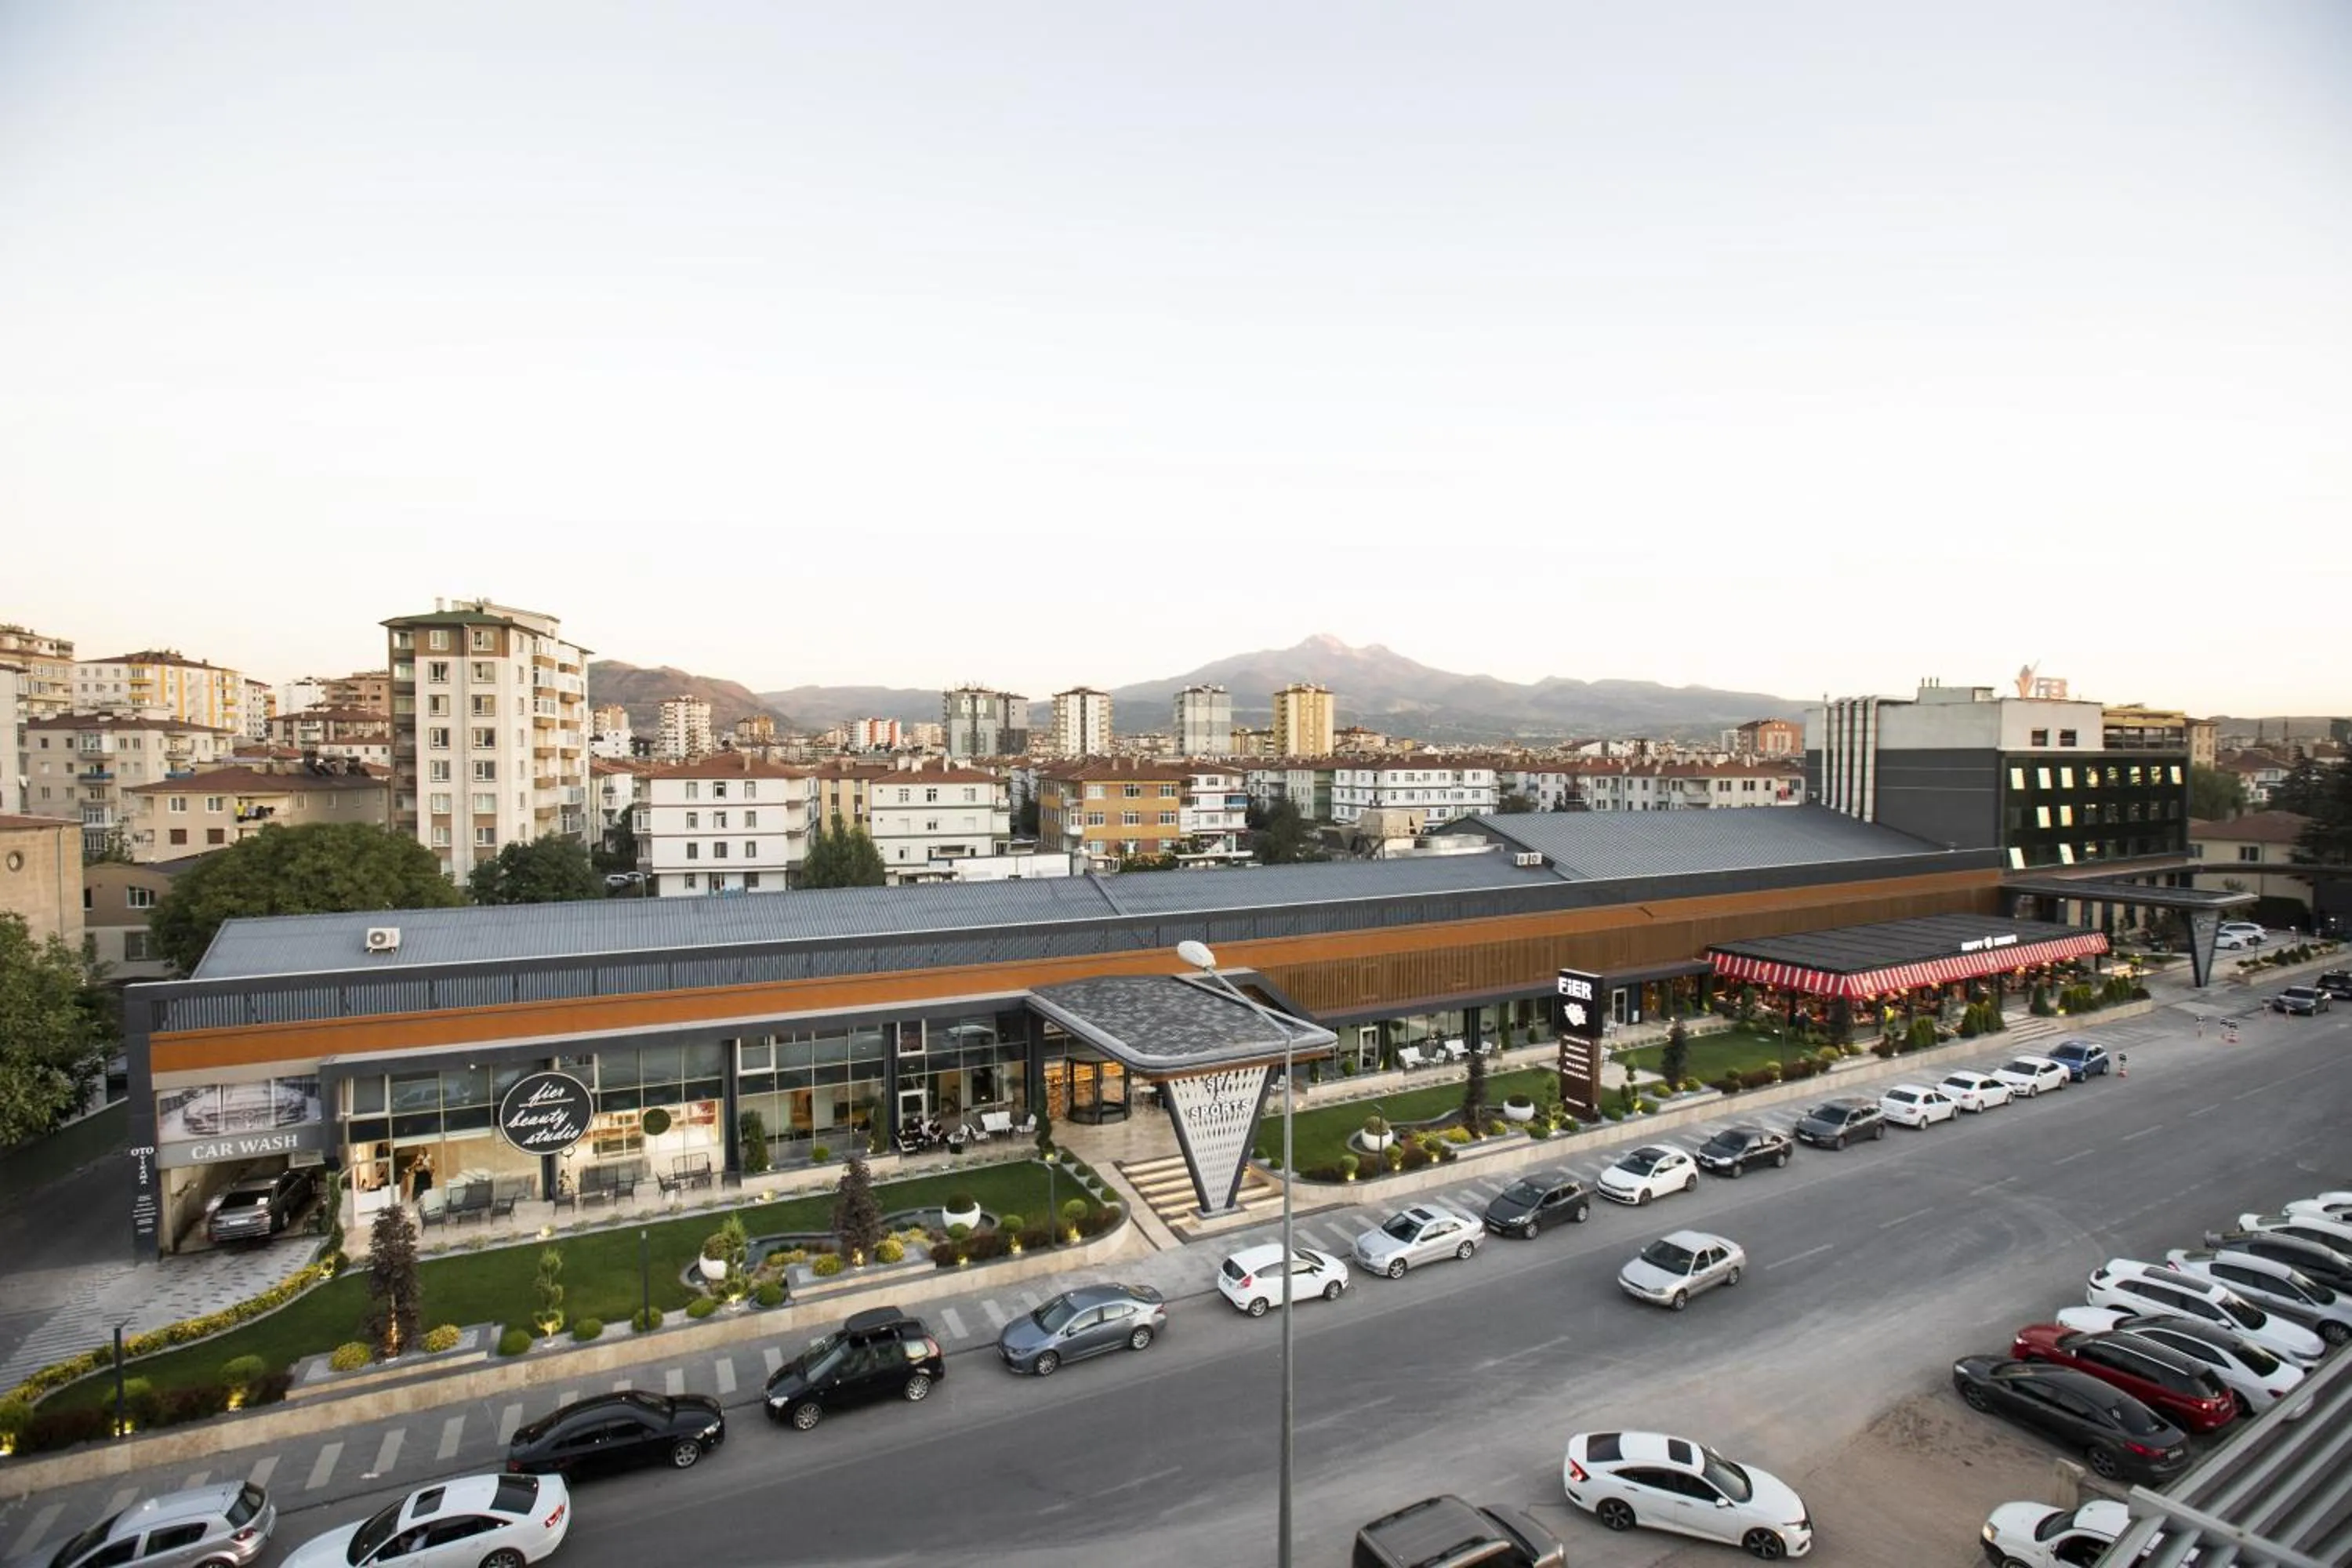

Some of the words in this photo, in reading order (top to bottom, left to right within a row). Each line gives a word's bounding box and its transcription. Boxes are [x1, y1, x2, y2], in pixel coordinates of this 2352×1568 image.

[1207, 1076, 1234, 1090] SPA
[506, 1108, 569, 1130] beauty
[1191, 1099, 1250, 1119] SPORTS
[522, 1123, 580, 1145] studio
[131, 1146, 154, 1156] OTO
[191, 1142, 233, 1160] CAR
[240, 1134, 298, 1155] WASH
